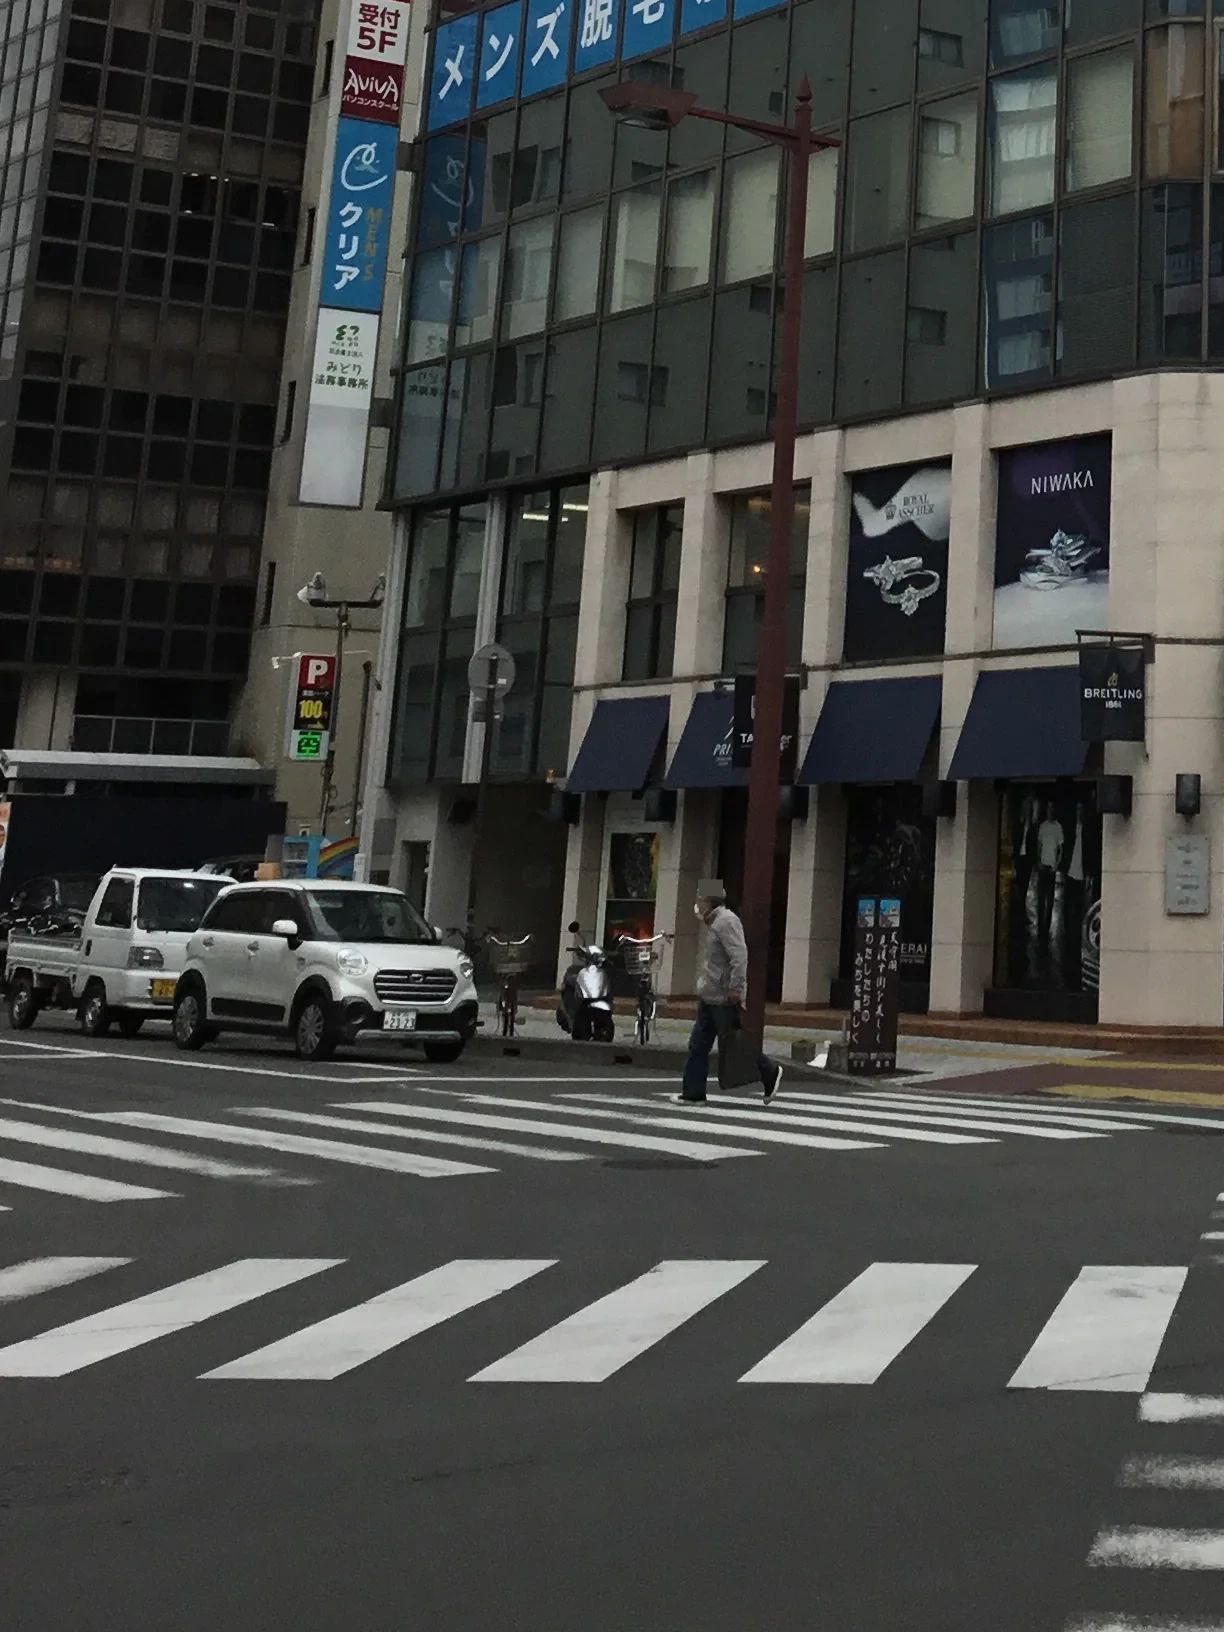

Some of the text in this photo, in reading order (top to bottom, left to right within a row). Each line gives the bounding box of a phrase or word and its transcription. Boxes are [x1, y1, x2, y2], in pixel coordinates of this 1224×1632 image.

[358, 3, 400, 30] 受付
[357, 27, 398, 54] 5F
[334, 202, 363, 290] クリア
[326, 361, 362, 375] みどり
[1031, 470, 1094, 495] NIWAKA
[903, 493, 929, 506] ROYAL
[307, 659, 328, 685] P
[1084, 688, 1143, 699] BREITLING
[299, 699, 324, 718] 100
